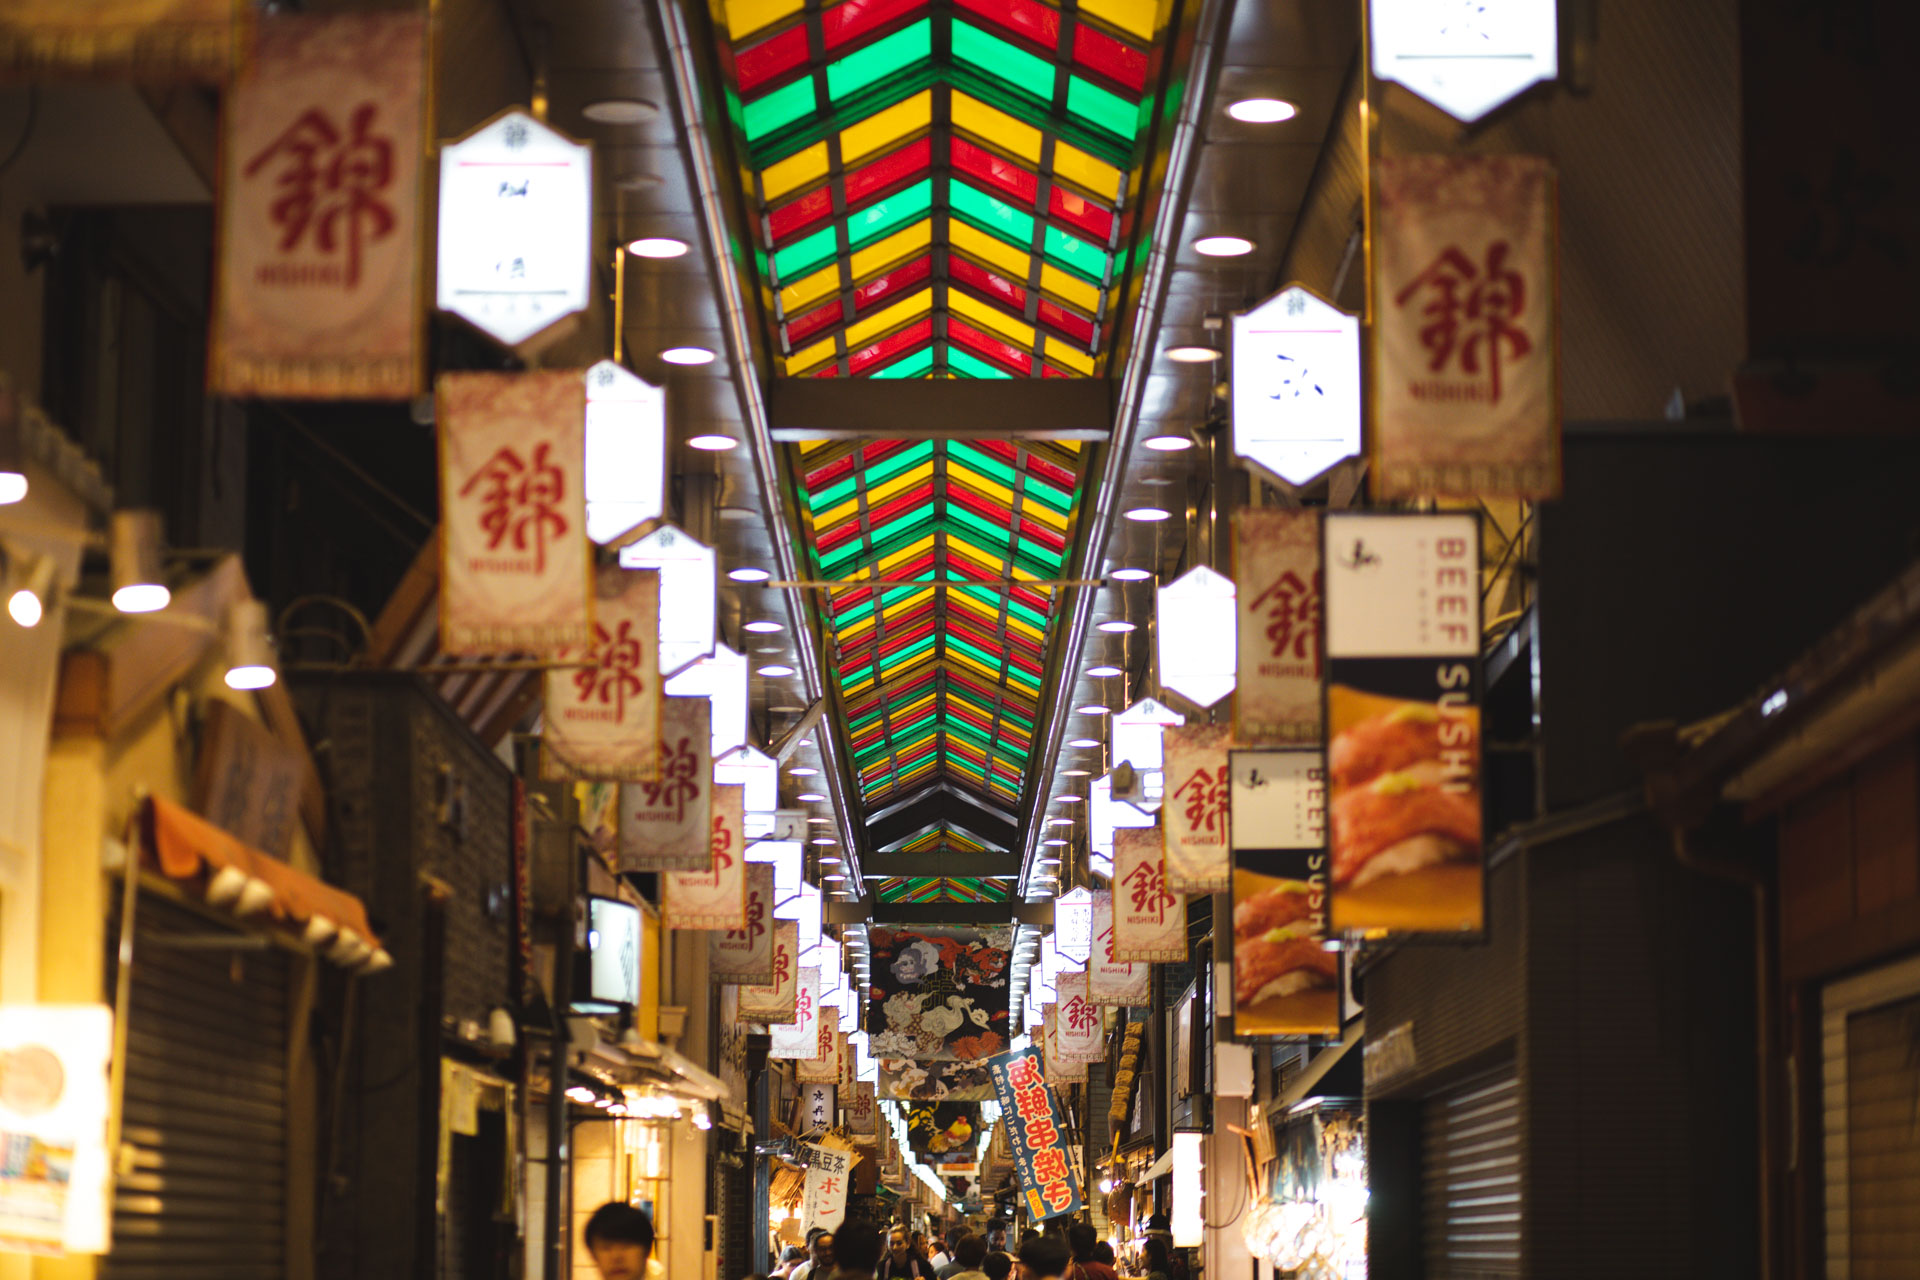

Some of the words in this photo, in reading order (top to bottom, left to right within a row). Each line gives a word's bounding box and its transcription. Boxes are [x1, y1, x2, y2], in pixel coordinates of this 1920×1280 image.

[245, 103, 398, 291] 錦
[1395, 242, 1531, 406] 錦
[459, 442, 568, 574] 錦
[469, 557, 532, 572] NISHIKI
[1437, 538, 1469, 643] BEEF
[564, 708, 614, 722] NISHIKI
[1437, 664, 1471, 793] SUSHI
[636, 811, 678, 823] NISHIKI
[1181, 836, 1219, 846] NISHIKI
[678, 877, 714, 887] NISHIKI
[1127, 916, 1159, 924] NISHIKI
[719, 942, 749, 951] NISHIKI
[809, 1150, 846, 1175] 黒豆茶
[818, 1176, 840, 1215] ポン
